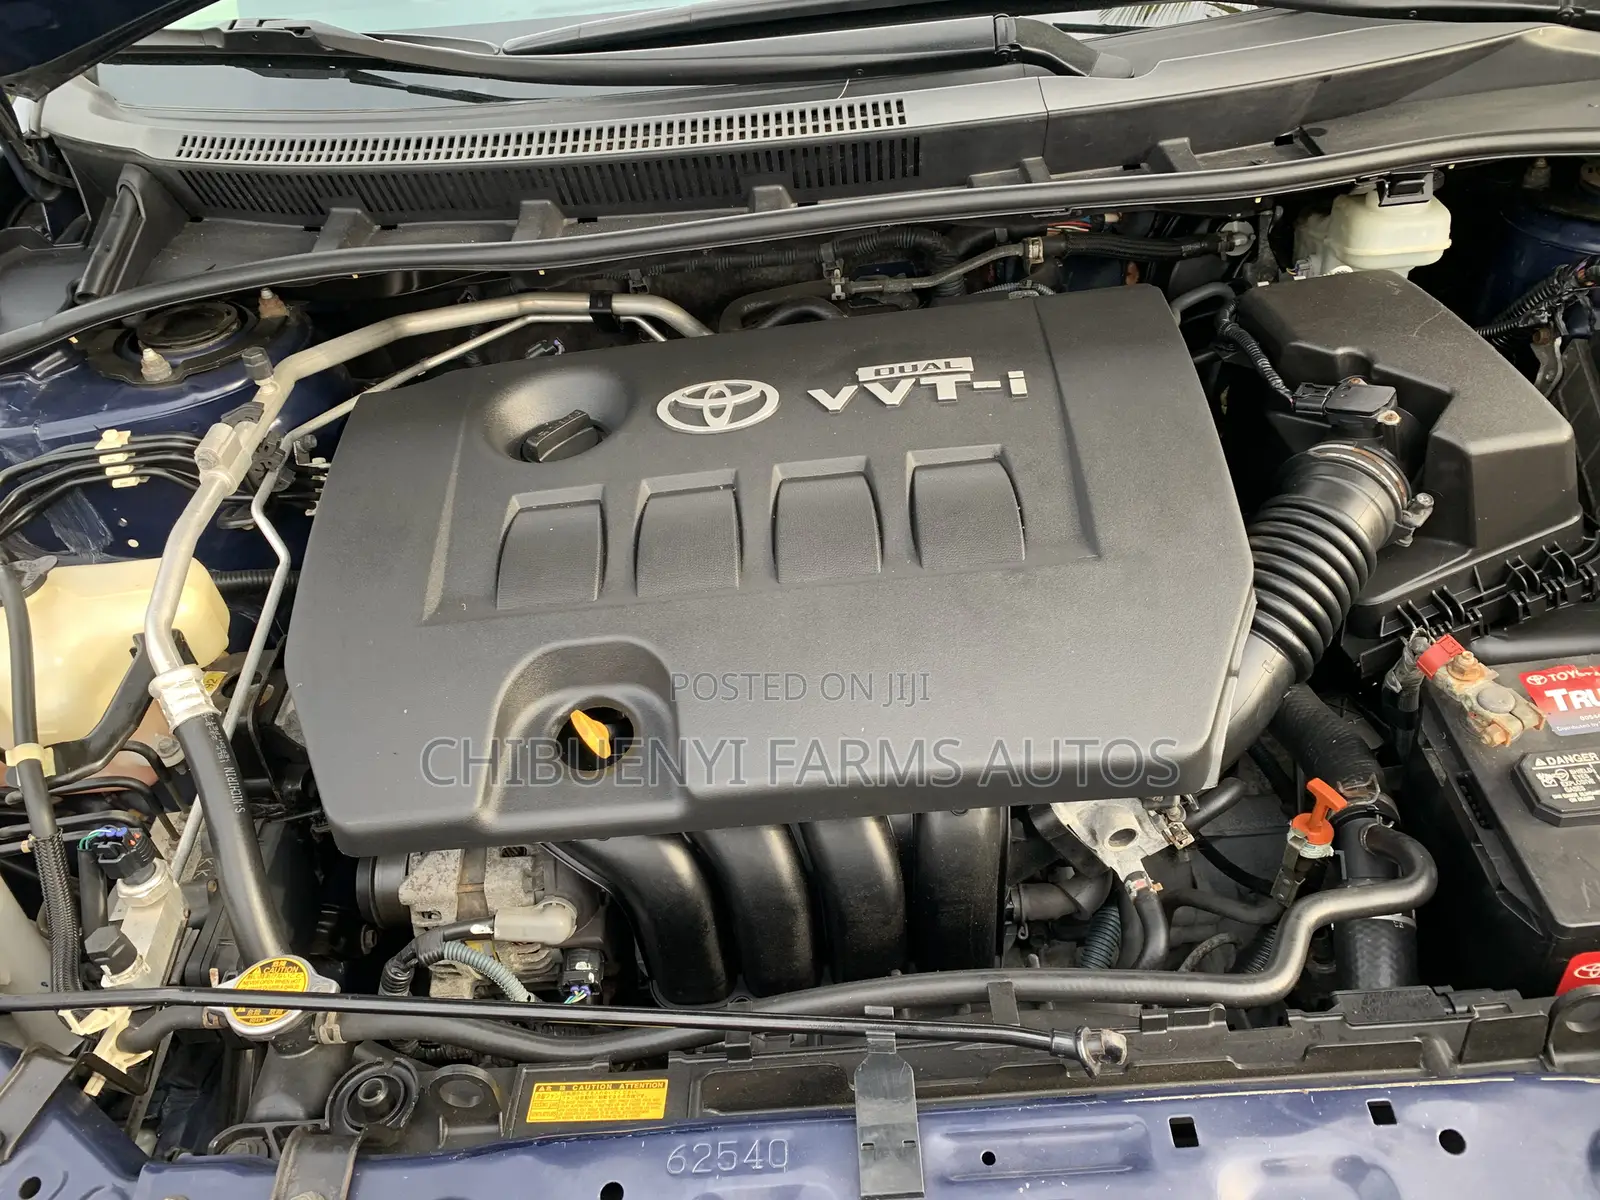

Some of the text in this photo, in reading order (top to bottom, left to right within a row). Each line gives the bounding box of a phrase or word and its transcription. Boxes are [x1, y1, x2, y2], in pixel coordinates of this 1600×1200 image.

[873, 360, 964, 377] DUAL
[807, 370, 1028, 413] VVT-i
[1545, 752, 1600, 766] DANGER
[263, 966, 299, 974] CAUTION
[572, 1082, 664, 1091] CAUTION ATTENTION
[666, 1138, 789, 1175] 62540
